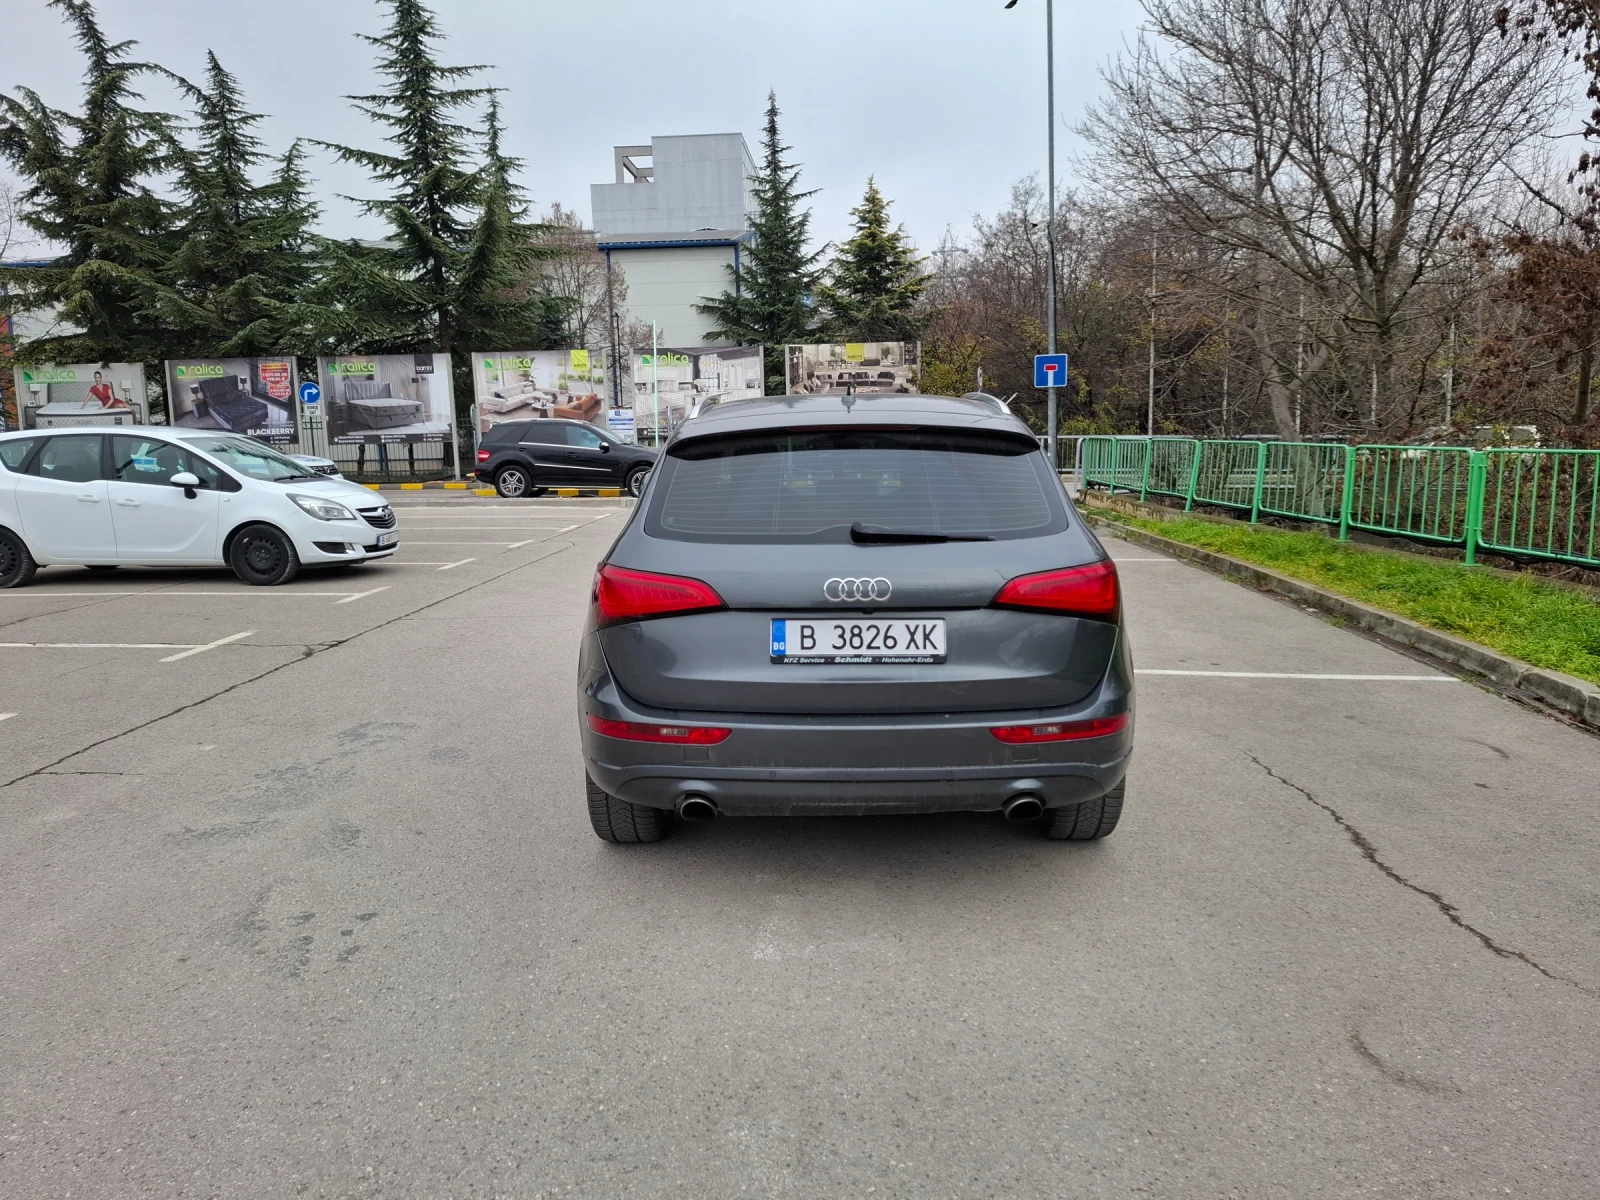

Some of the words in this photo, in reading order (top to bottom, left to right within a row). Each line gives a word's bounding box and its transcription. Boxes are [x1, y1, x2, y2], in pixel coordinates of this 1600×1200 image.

[341, 361, 376, 372] ralica
[495, 356, 532, 368] ralica
[36, 367, 77, 380] ralica
[188, 363, 224, 375] ralica
[247, 428, 295, 436] BLACKBERRY
[800, 625, 816, 650] B
[832, 624, 898, 650] 3826
[905, 624, 939, 650] XK
[773, 642, 785, 650] BG
